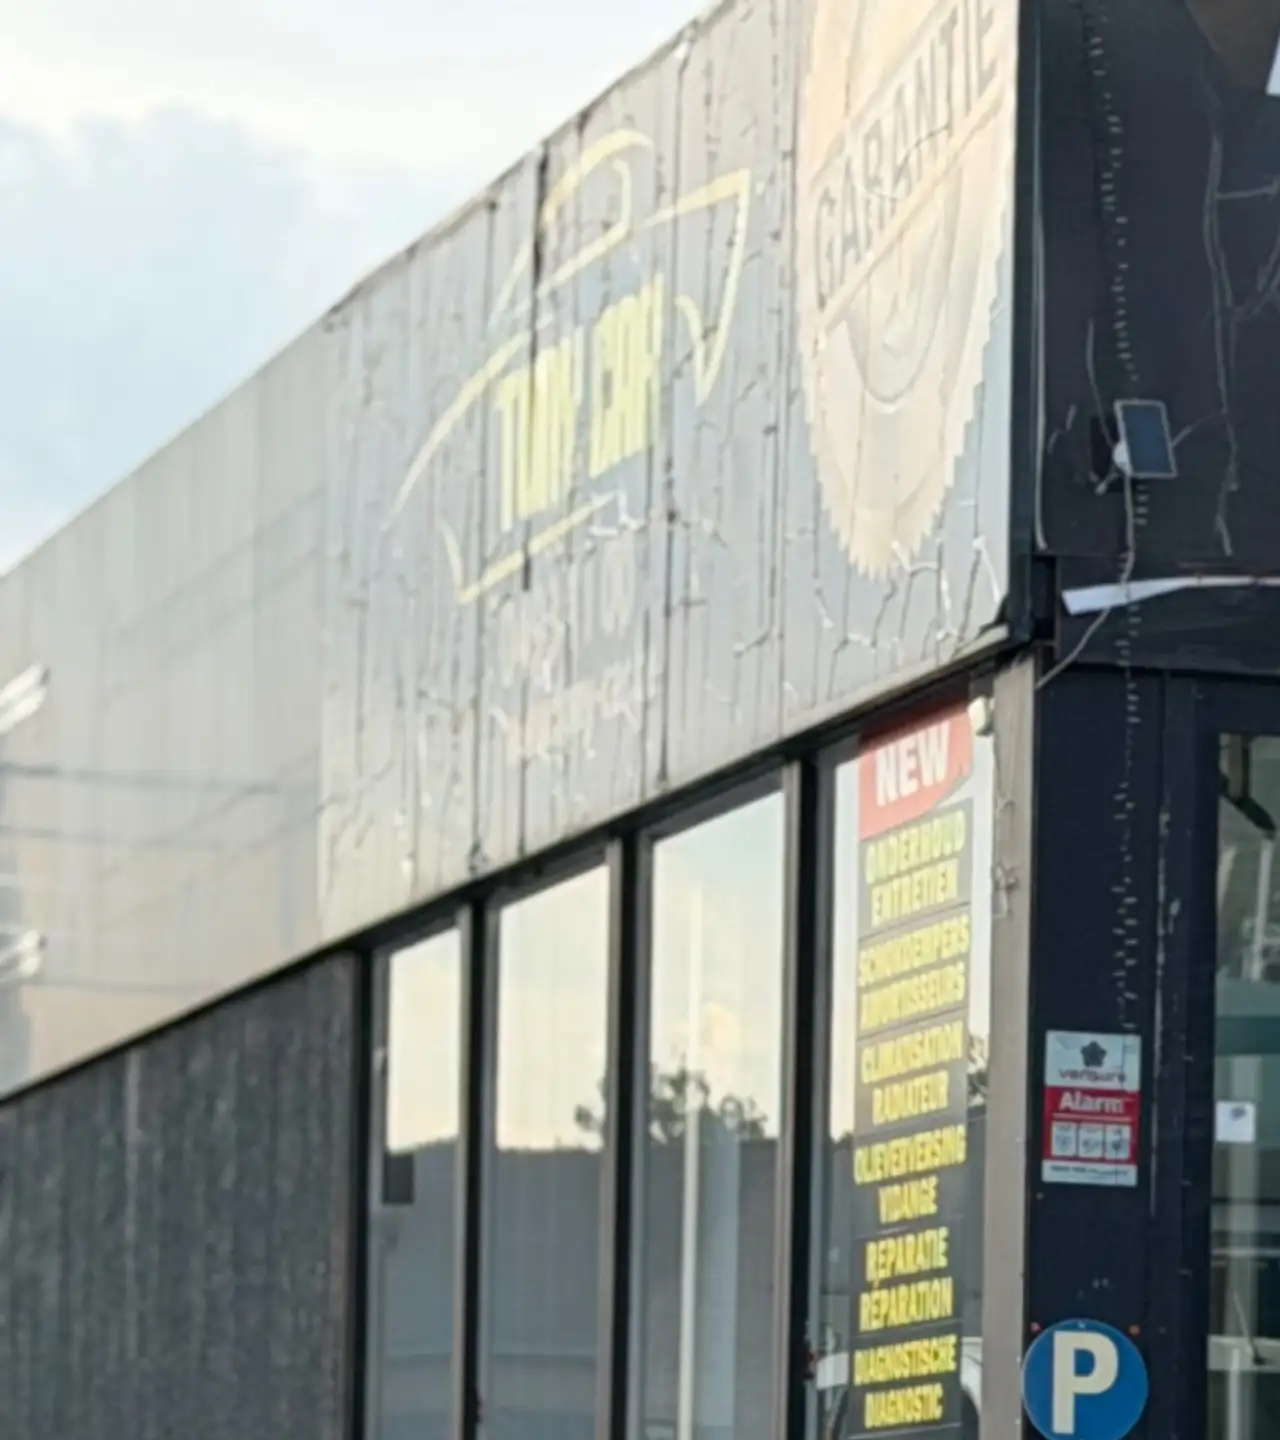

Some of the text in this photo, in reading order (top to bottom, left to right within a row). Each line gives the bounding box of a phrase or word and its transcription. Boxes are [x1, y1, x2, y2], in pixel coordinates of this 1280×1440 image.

[876, 724, 949, 804] NEW
[870, 858, 959, 926] ENTRETIEN
[1059, 1091, 1125, 1114] Alarm
[877, 1176, 938, 1224] VIDANGE
[866, 1227, 949, 1281] REPARATIE
[854, 1334, 957, 1386] DIAGNOSTISCHE
[1052, 1331, 1118, 1434] P
[864, 1383, 944, 1429] DIAGNOSTIC
